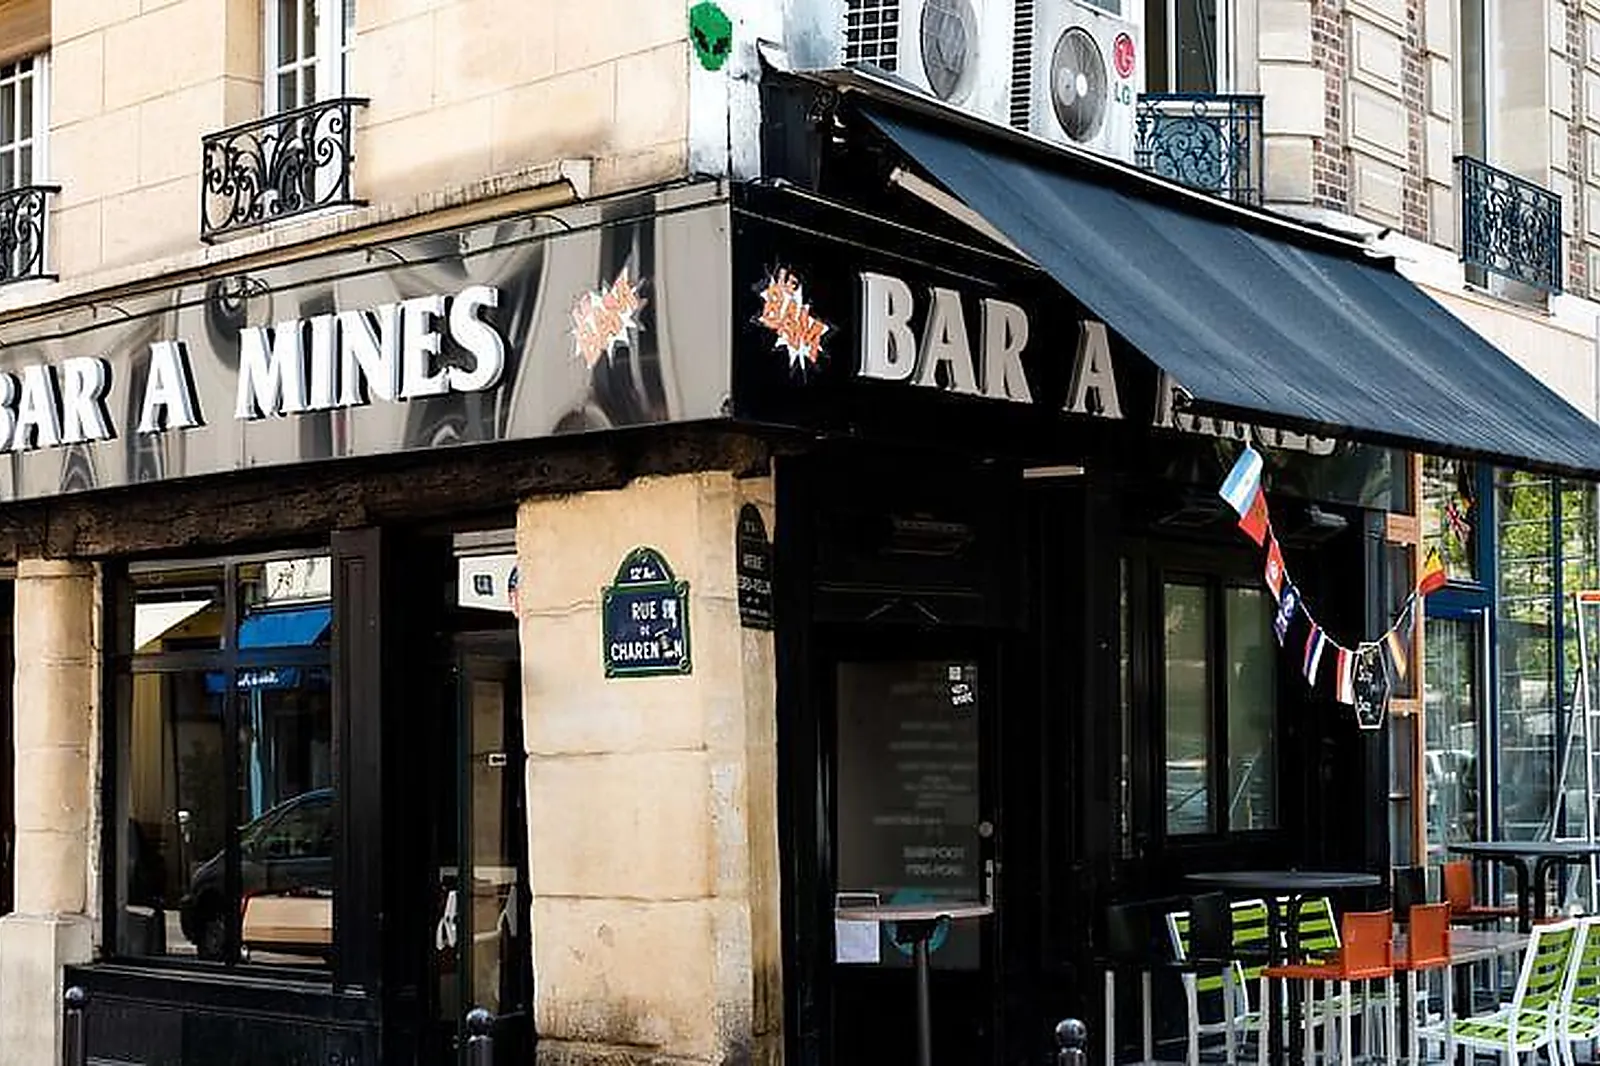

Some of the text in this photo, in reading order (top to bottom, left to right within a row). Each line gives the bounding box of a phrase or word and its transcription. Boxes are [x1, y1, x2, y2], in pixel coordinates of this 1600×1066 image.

[138, 341, 204, 433] A
[235, 286, 506, 419] MINES
[857, 271, 1033, 404] BAR
[1065, 320, 1124, 419] A
[610, 641, 683, 661] CHARENN
[631, 600, 658, 621] RUE
